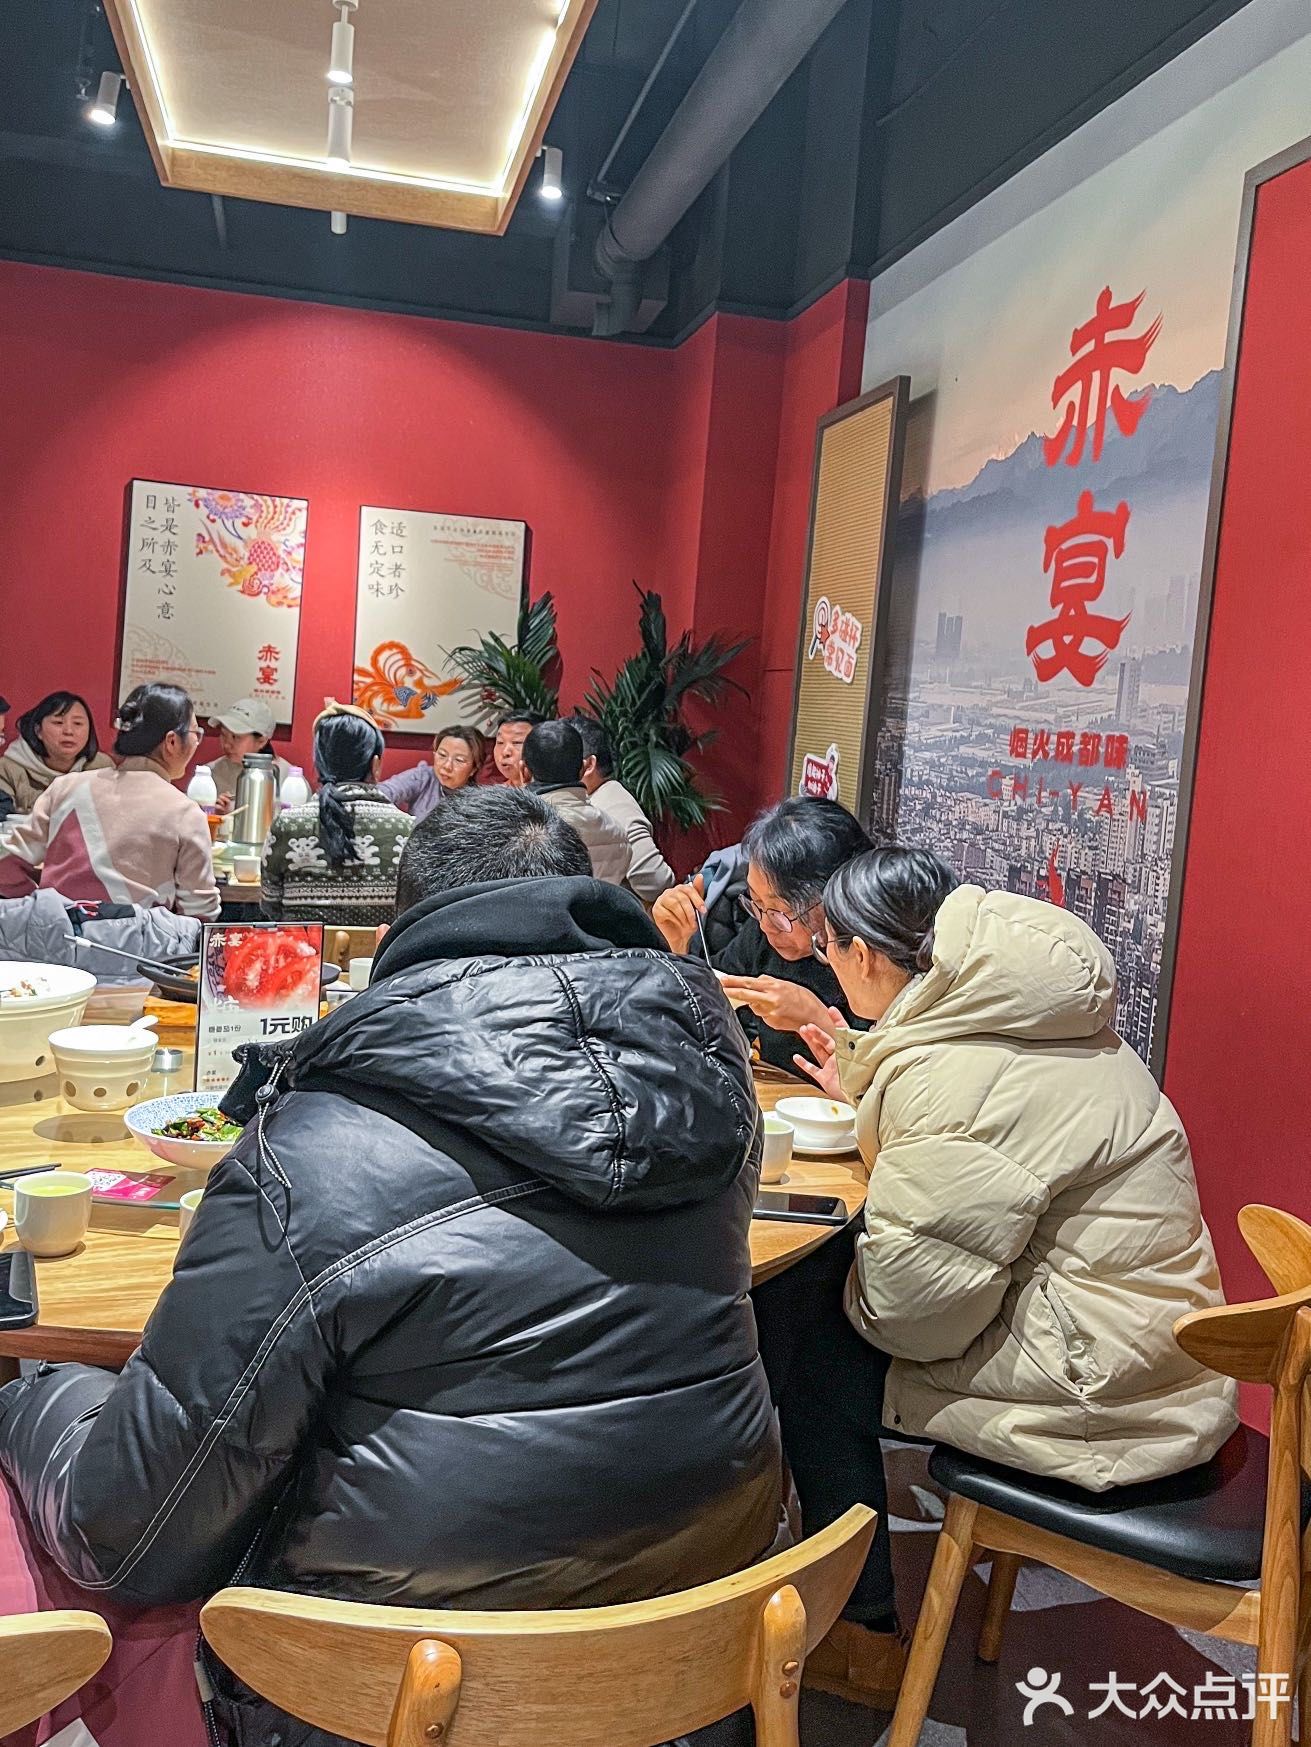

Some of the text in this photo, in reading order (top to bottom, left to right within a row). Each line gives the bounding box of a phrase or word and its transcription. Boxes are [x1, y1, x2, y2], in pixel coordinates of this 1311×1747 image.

[1025, 285, 1164, 688] 赤宴
[156, 495, 181, 620] 皆是赤宴心意
[368, 519, 388, 598] 食无定味
[387, 521, 408, 600] 适口者珍
[256, 644, 281, 686] 赤宴
[208, 932, 244, 948] 赤宴
[260, 1015, 313, 1036] 1元购
